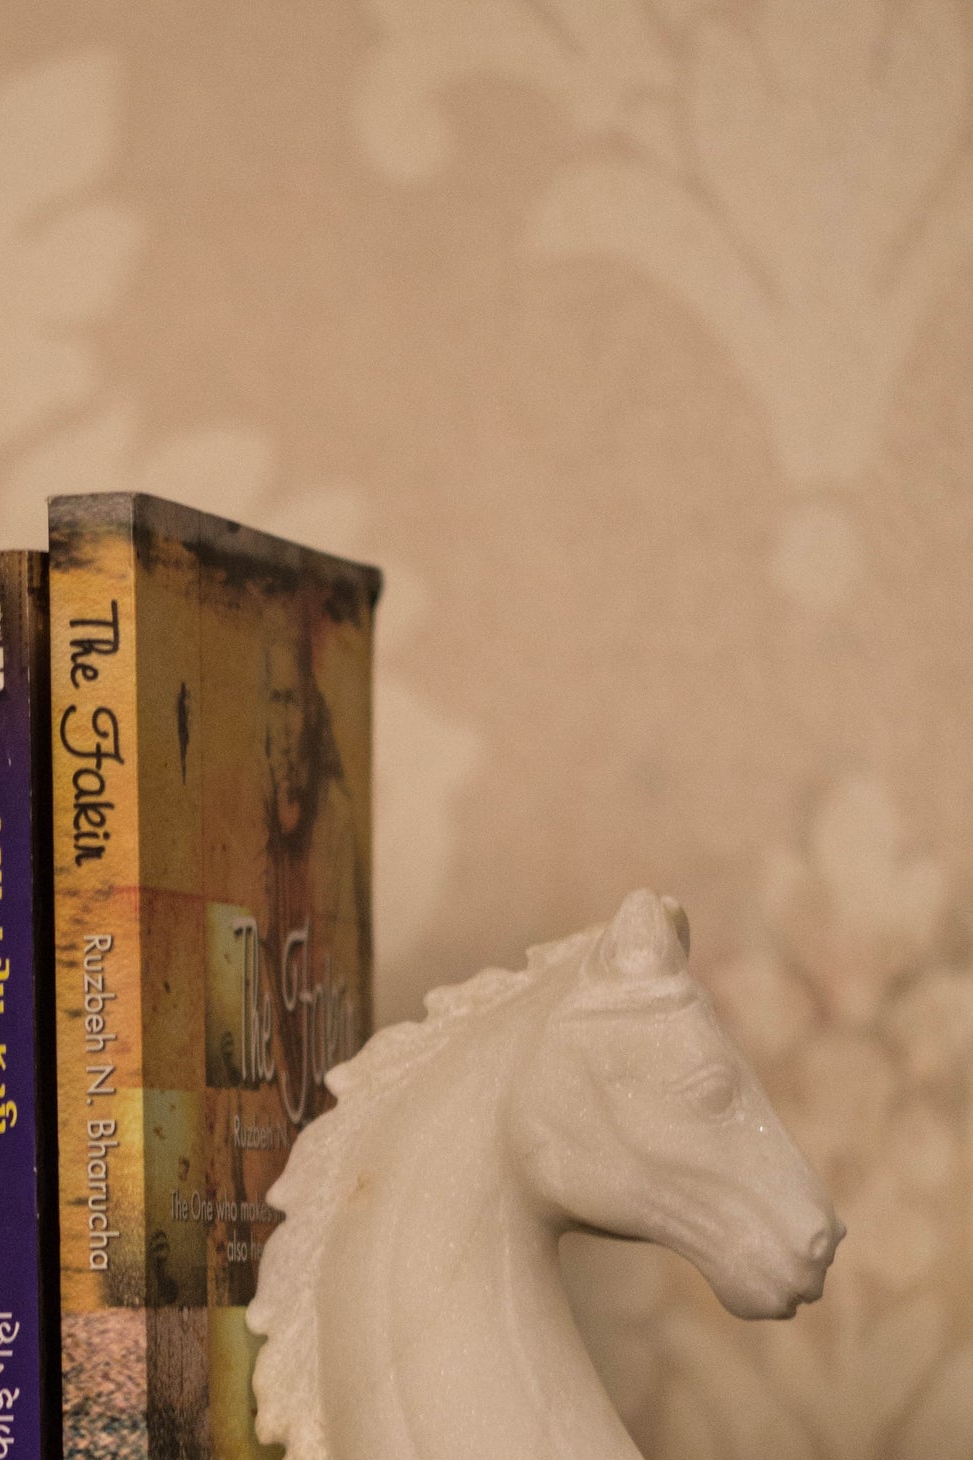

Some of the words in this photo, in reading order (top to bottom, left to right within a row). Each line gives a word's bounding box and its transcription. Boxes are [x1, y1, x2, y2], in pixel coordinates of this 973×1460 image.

[68, 599, 120, 689] The
[60, 704, 125, 867] Fakir
[82, 933, 118, 1050] Ruzbeh
[231, 917, 275, 1082] The
[85, 1064, 116, 1105] N.
[86, 1118, 121, 1271] Bharucha
[170, 1190, 188, 1220] The
[190, 1190, 213, 1221] One
[216, 1192, 238, 1221] who
[227, 1229, 248, 1262] also
